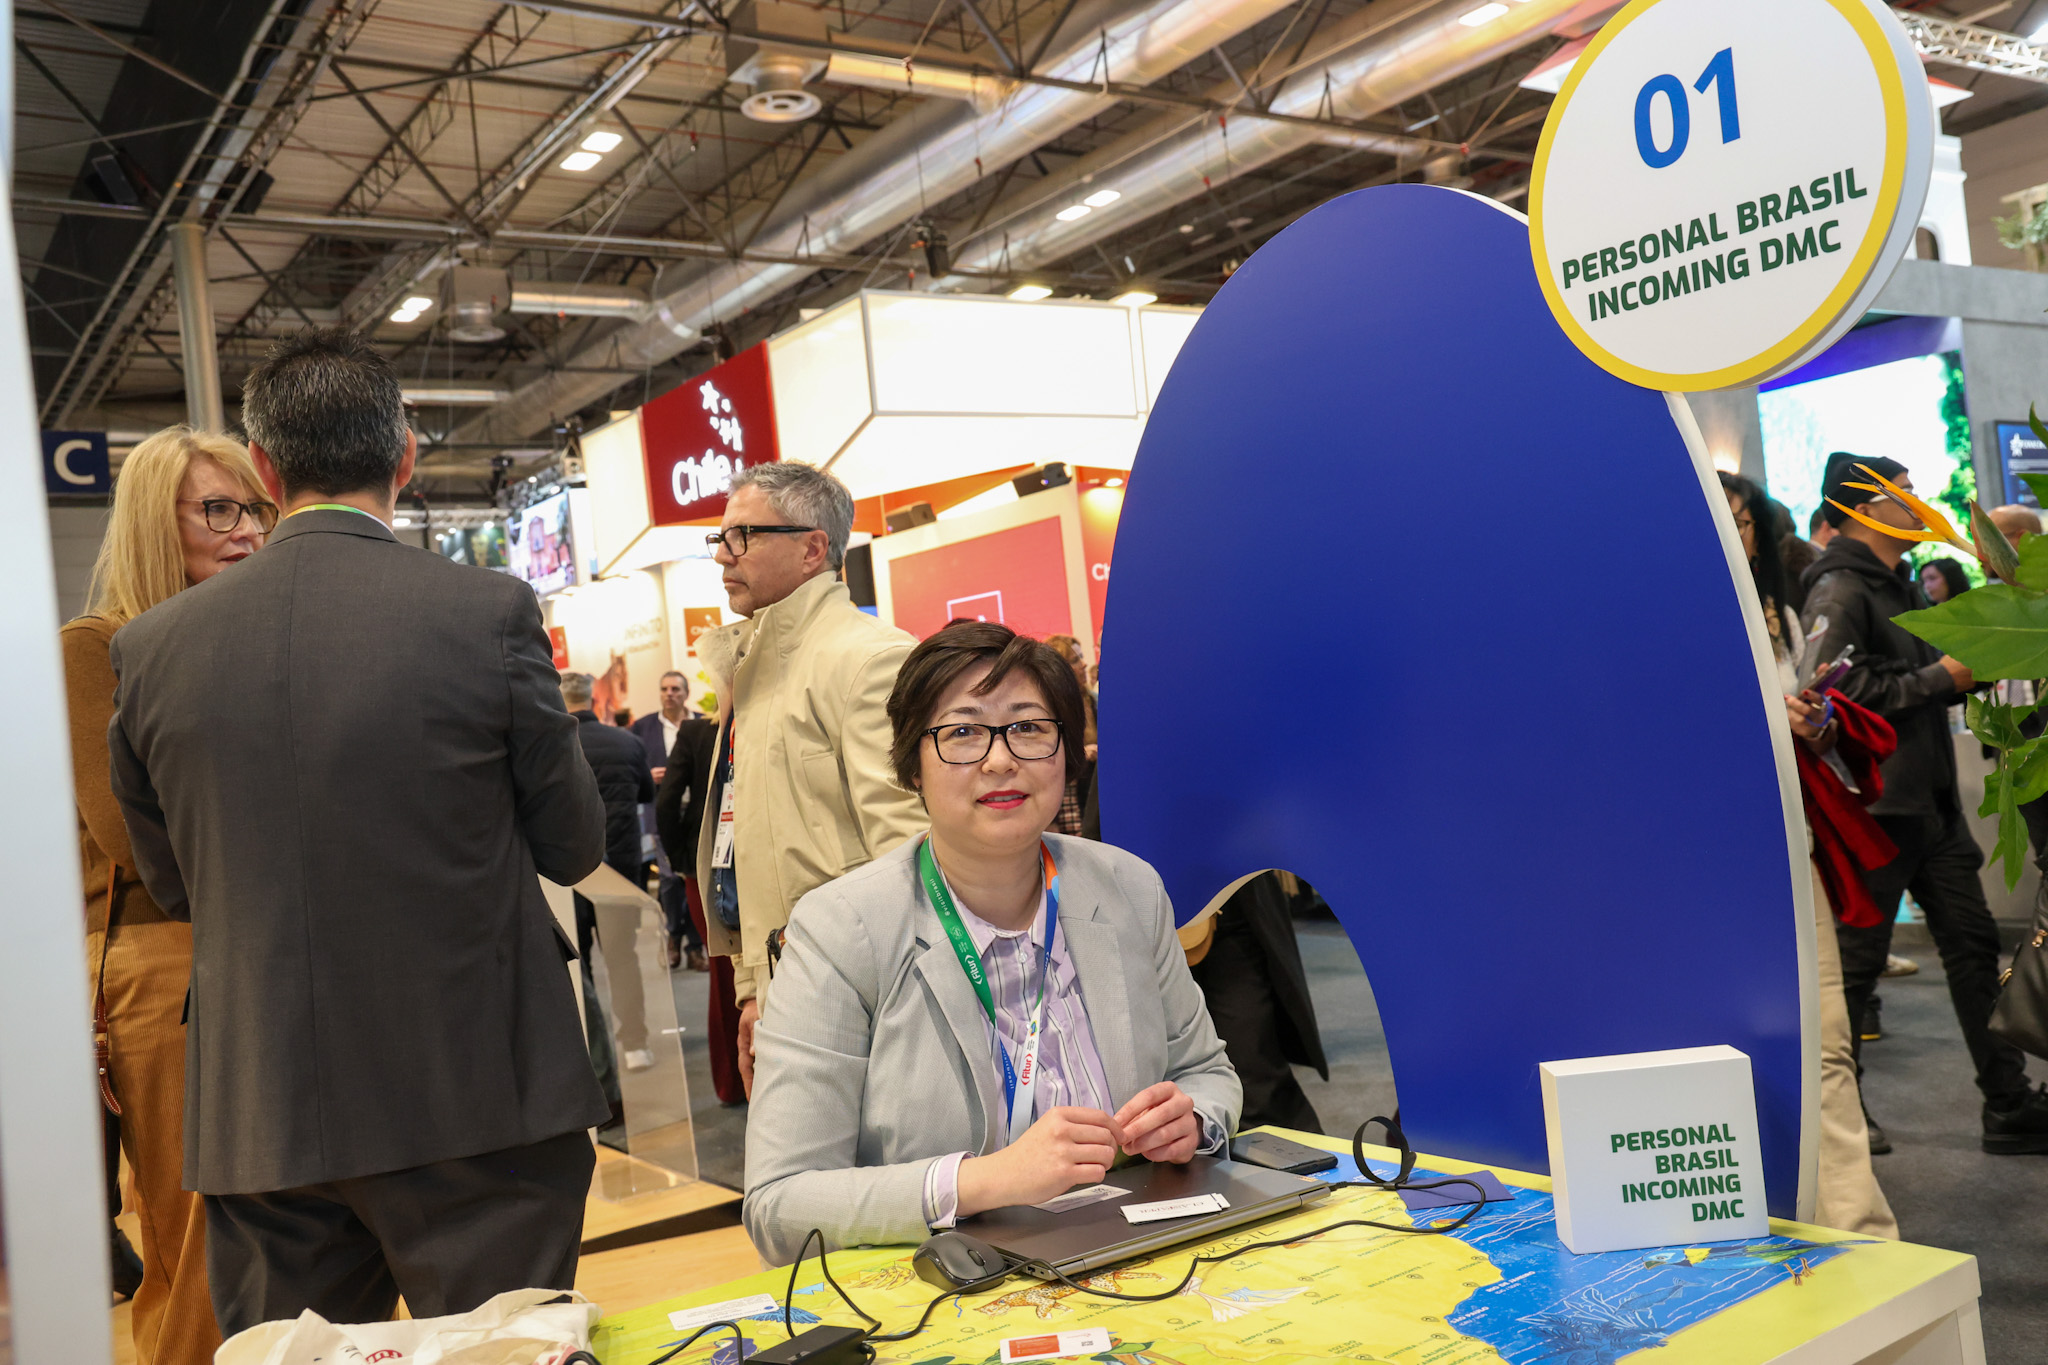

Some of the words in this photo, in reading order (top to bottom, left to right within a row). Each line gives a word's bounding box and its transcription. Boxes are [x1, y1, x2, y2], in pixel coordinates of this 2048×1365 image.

[1633, 46, 1742, 169] 01
[1562, 212, 1728, 289] PERSONAL
[1737, 167, 1867, 235] BRASIL
[1588, 247, 1749, 322] INCOMING
[1760, 220, 1841, 272] DMC
[53, 440, 95, 485] C
[672, 448, 732, 506] Chile
[1611, 1123, 1736, 1154] PERSONAL
[1655, 1148, 1740, 1175] BRASIL
[1622, 1173, 1742, 1205] INCOMING
[1691, 1199, 1745, 1224] DMC
[1416, 1349, 1456, 1365] AMBORIÚ
